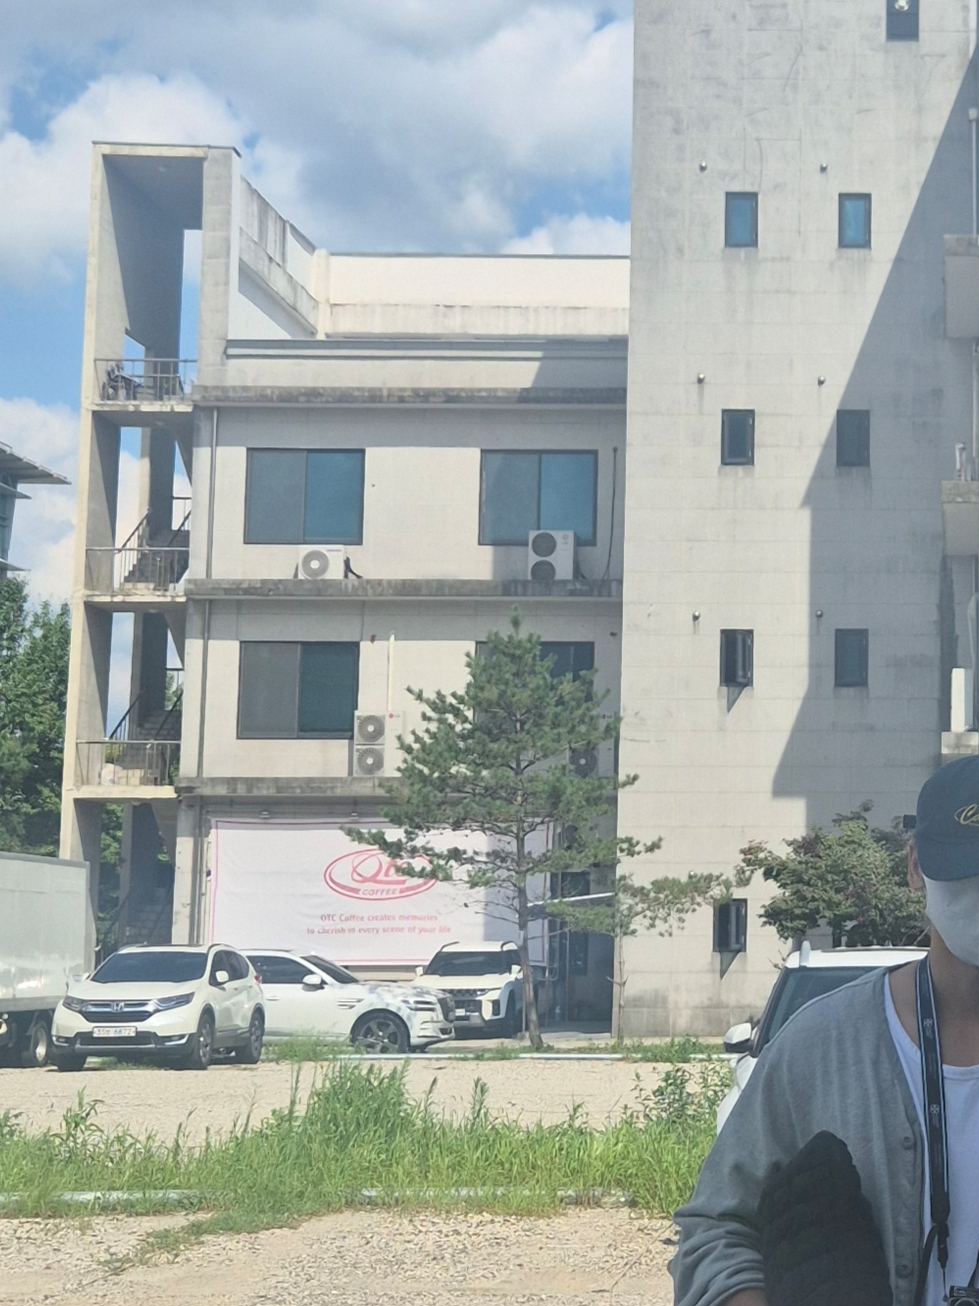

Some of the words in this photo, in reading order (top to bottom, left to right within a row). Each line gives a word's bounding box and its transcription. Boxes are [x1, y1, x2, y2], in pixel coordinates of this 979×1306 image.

[362, 888, 398, 896] COFFEE
[320, 914, 337, 922] OTC
[339, 914, 365, 922] Coffee
[367, 914, 396, 922] creates
[358, 927, 380, 935] every
